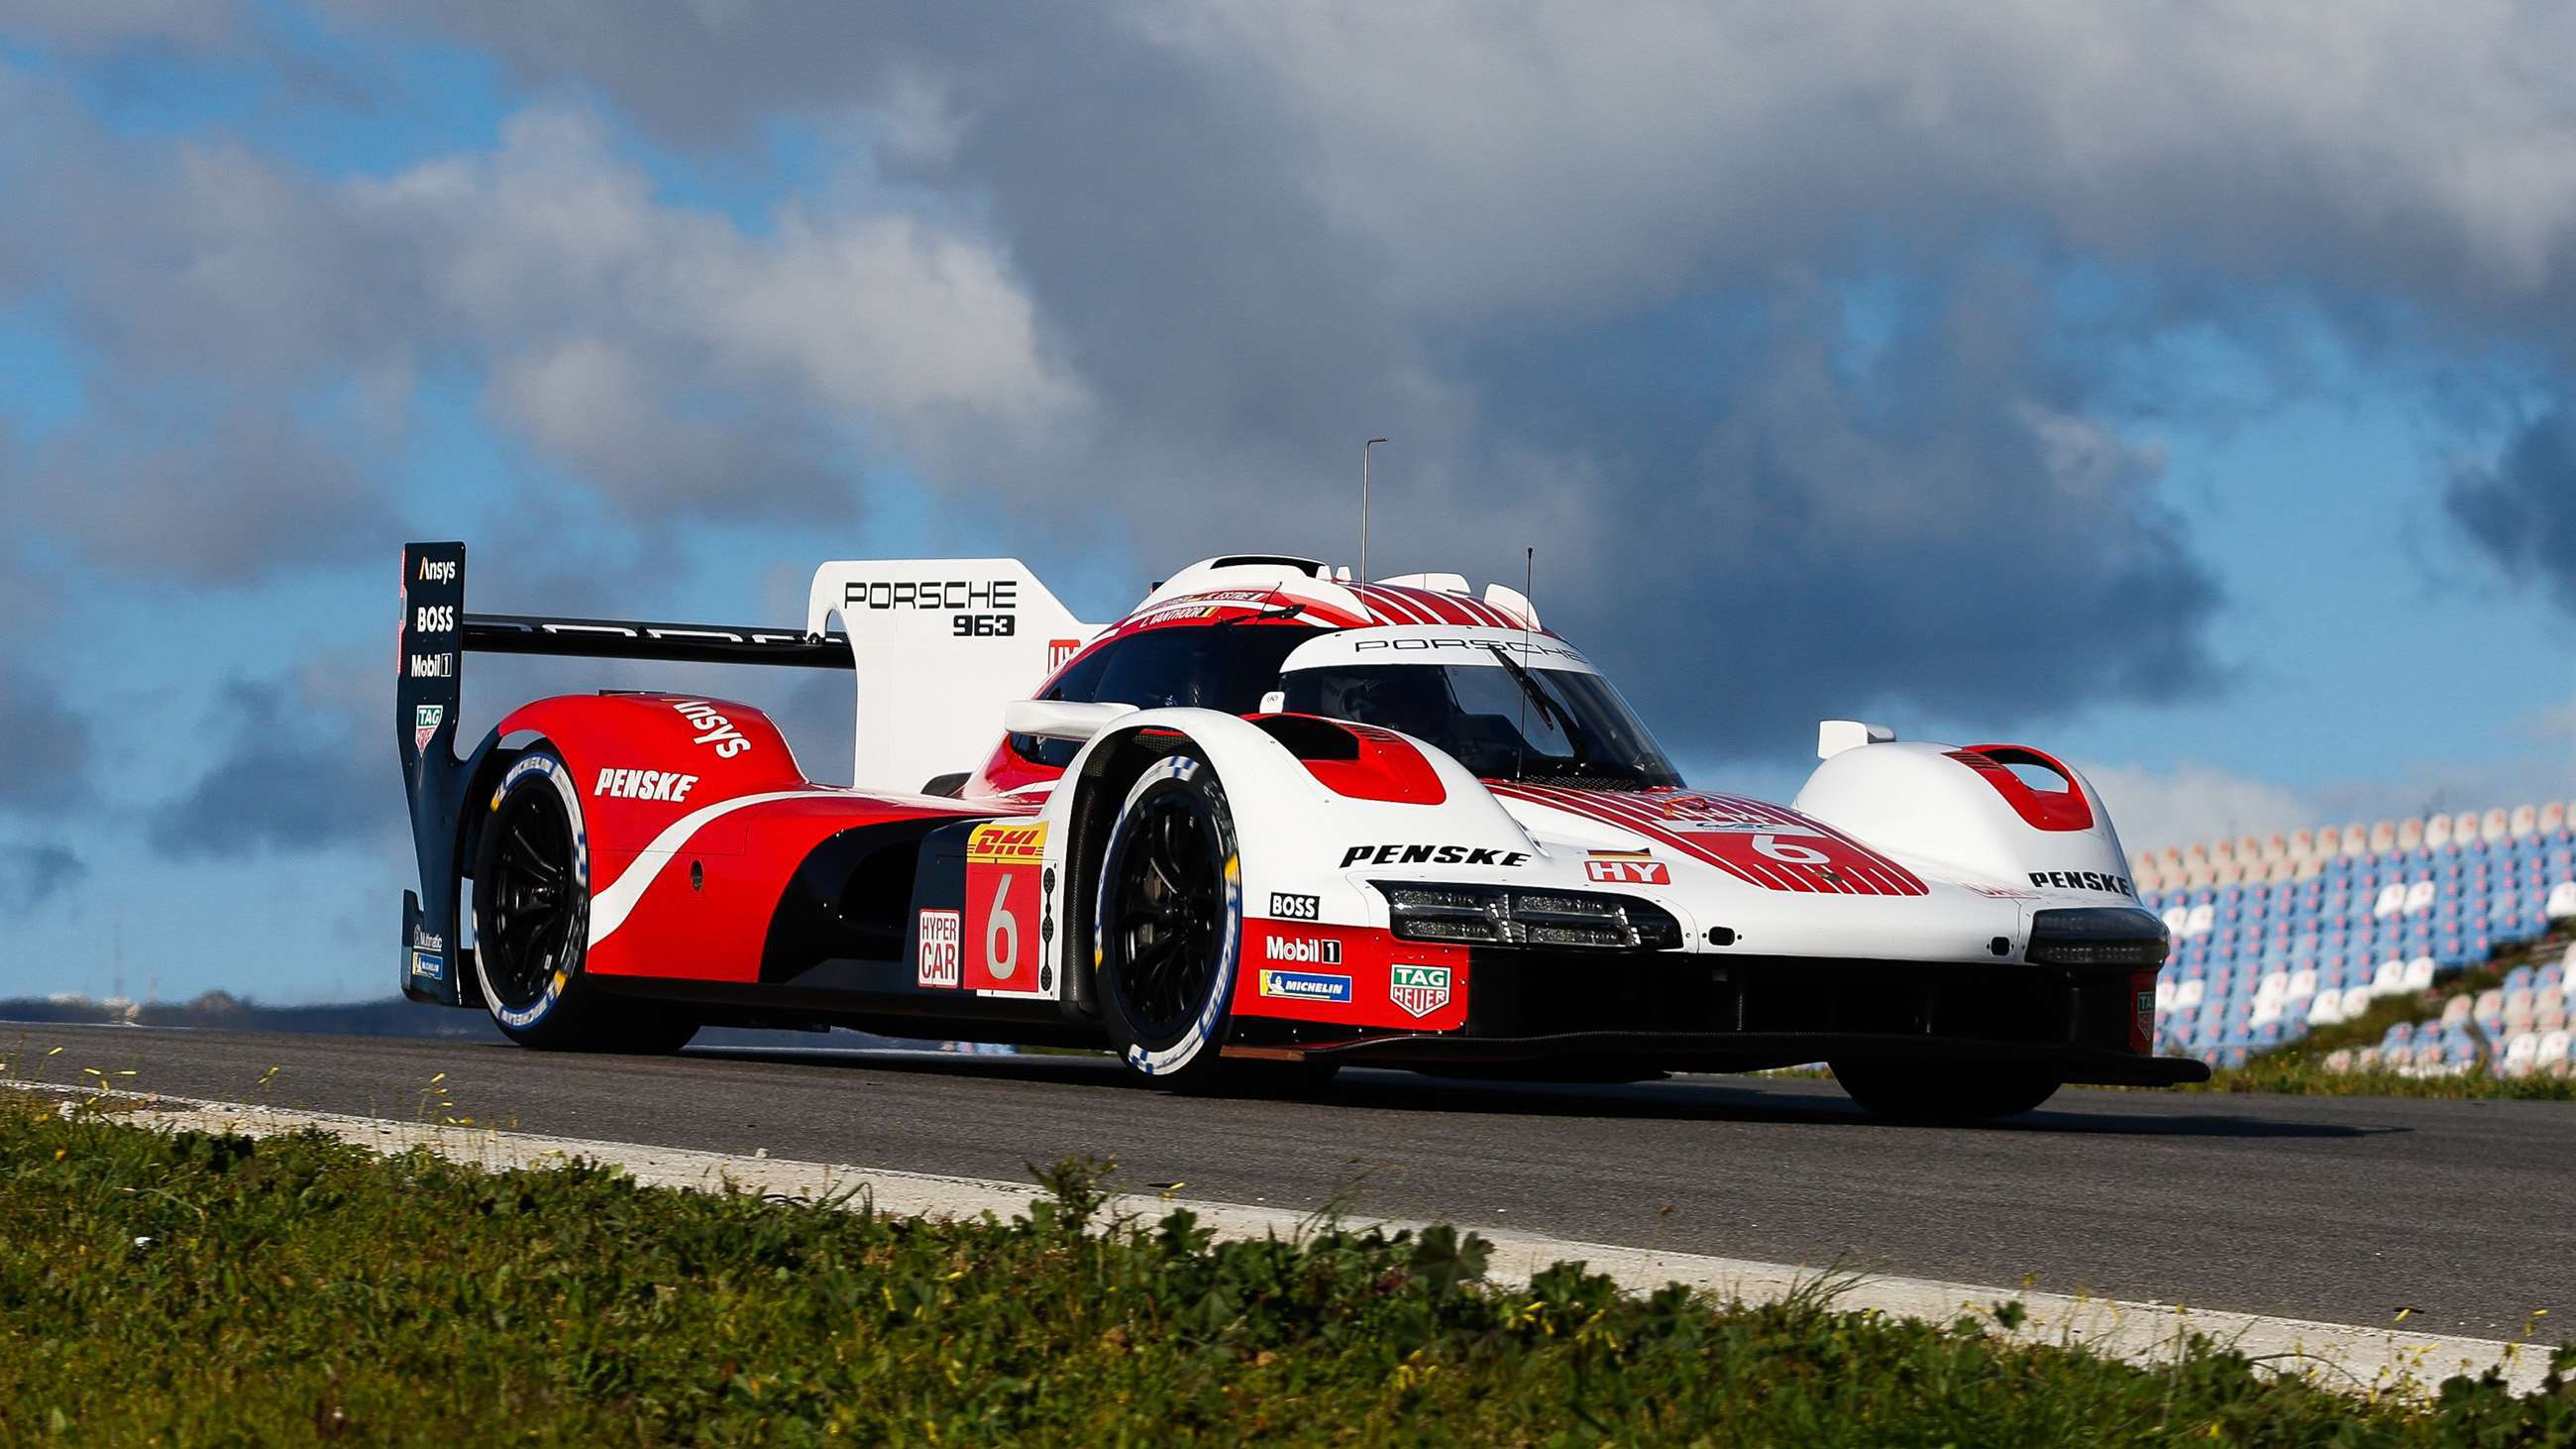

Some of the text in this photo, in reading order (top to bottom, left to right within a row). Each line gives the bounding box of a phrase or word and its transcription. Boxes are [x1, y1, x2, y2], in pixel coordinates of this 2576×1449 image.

[419, 556, 456, 585] Ansys
[844, 580, 1018, 610] PORSCHE
[417, 606, 454, 633] BOSS
[952, 614, 1016, 637] 963
[1354, 638, 1588, 664] PORSCHE
[411, 653, 441, 678] Mobil
[419, 709, 441, 725] TAG
[594, 767, 699, 803] PENSKE
[974, 830, 1039, 855] DHL
[1751, 834, 1831, 864] 6
[1339, 844, 1533, 869] PENSKE
[1589, 861, 1659, 882] HY
[2028, 871, 2132, 897] PENSKE
[1271, 895, 1317, 919] BOSS
[921, 917, 957, 942] HYPER
[986, 872, 1019, 980] 6
[921, 942, 956, 980] CAR
[1266, 936, 1319, 962] Mobil
[1285, 979, 1343, 995] MICHELIN
[1396, 968, 1446, 987] TAG
[1394, 987, 1446, 1014] HEUER
